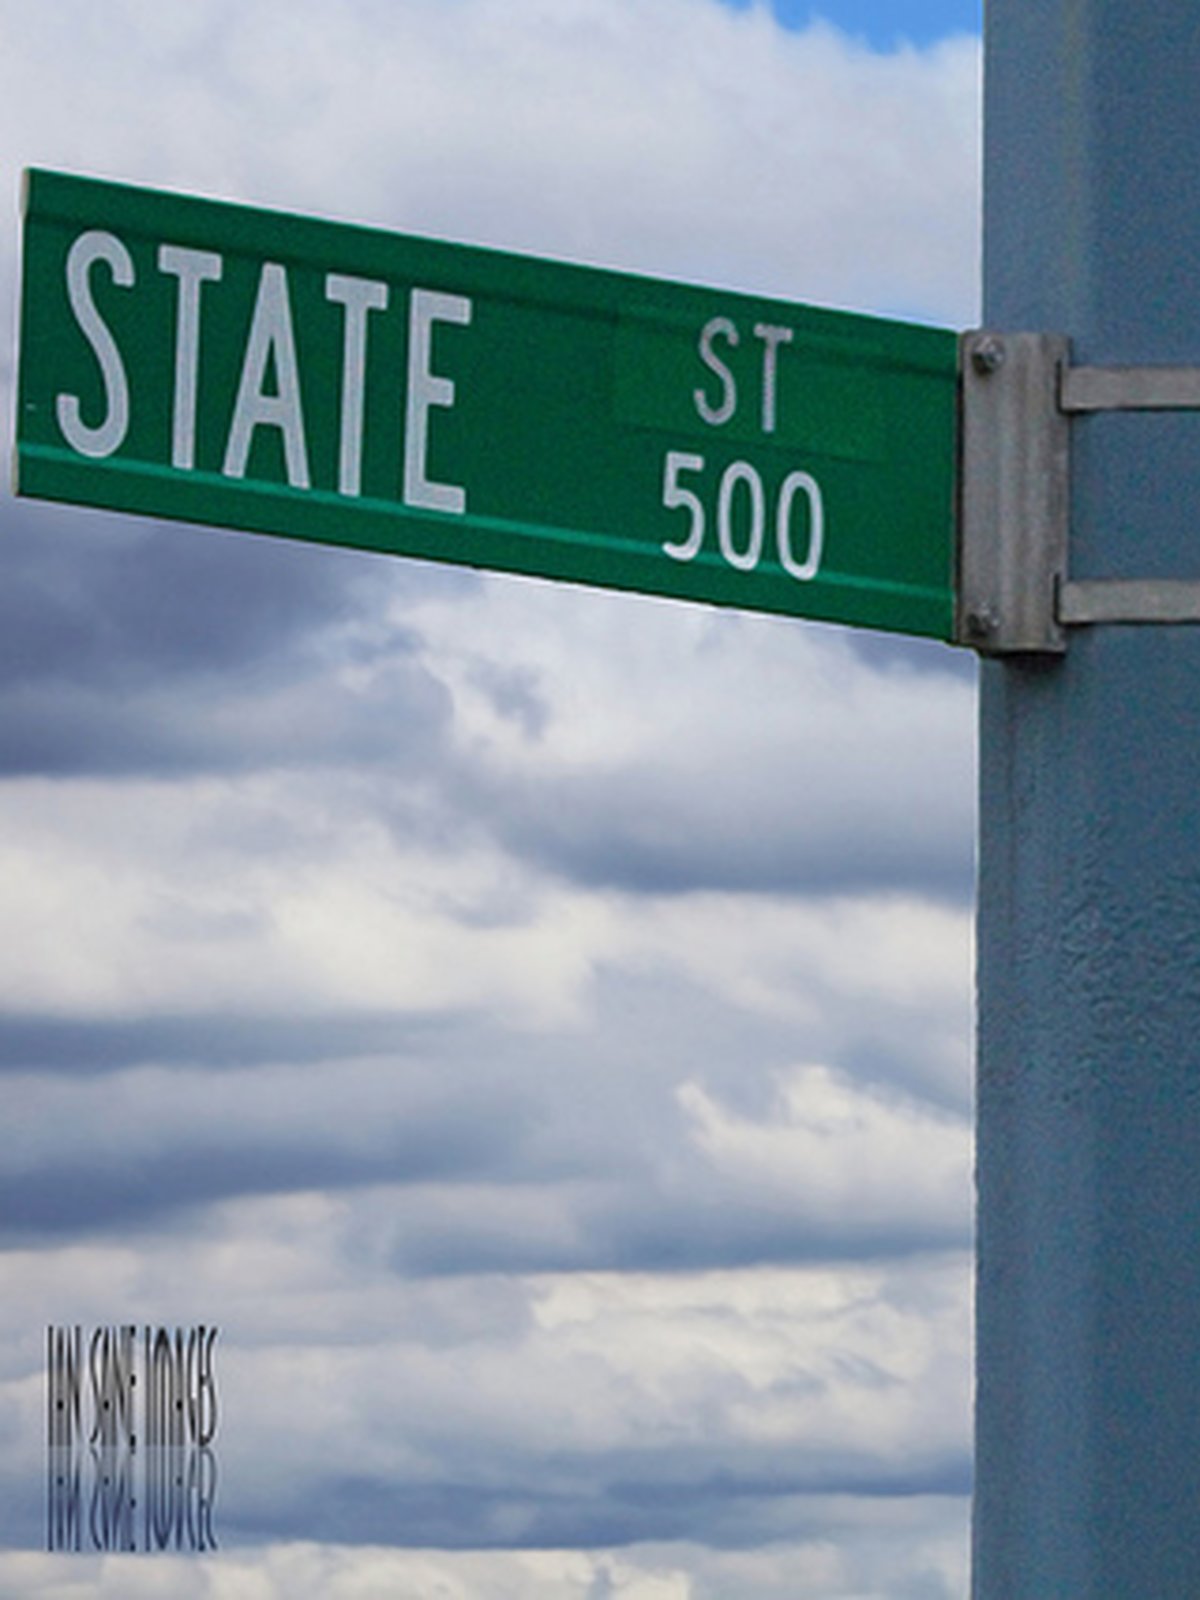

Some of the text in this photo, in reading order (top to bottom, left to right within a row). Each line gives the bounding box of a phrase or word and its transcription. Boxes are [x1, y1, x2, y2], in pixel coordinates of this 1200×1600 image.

[55, 229, 793, 514] STATE ST
[662, 451, 824, 581] 500
